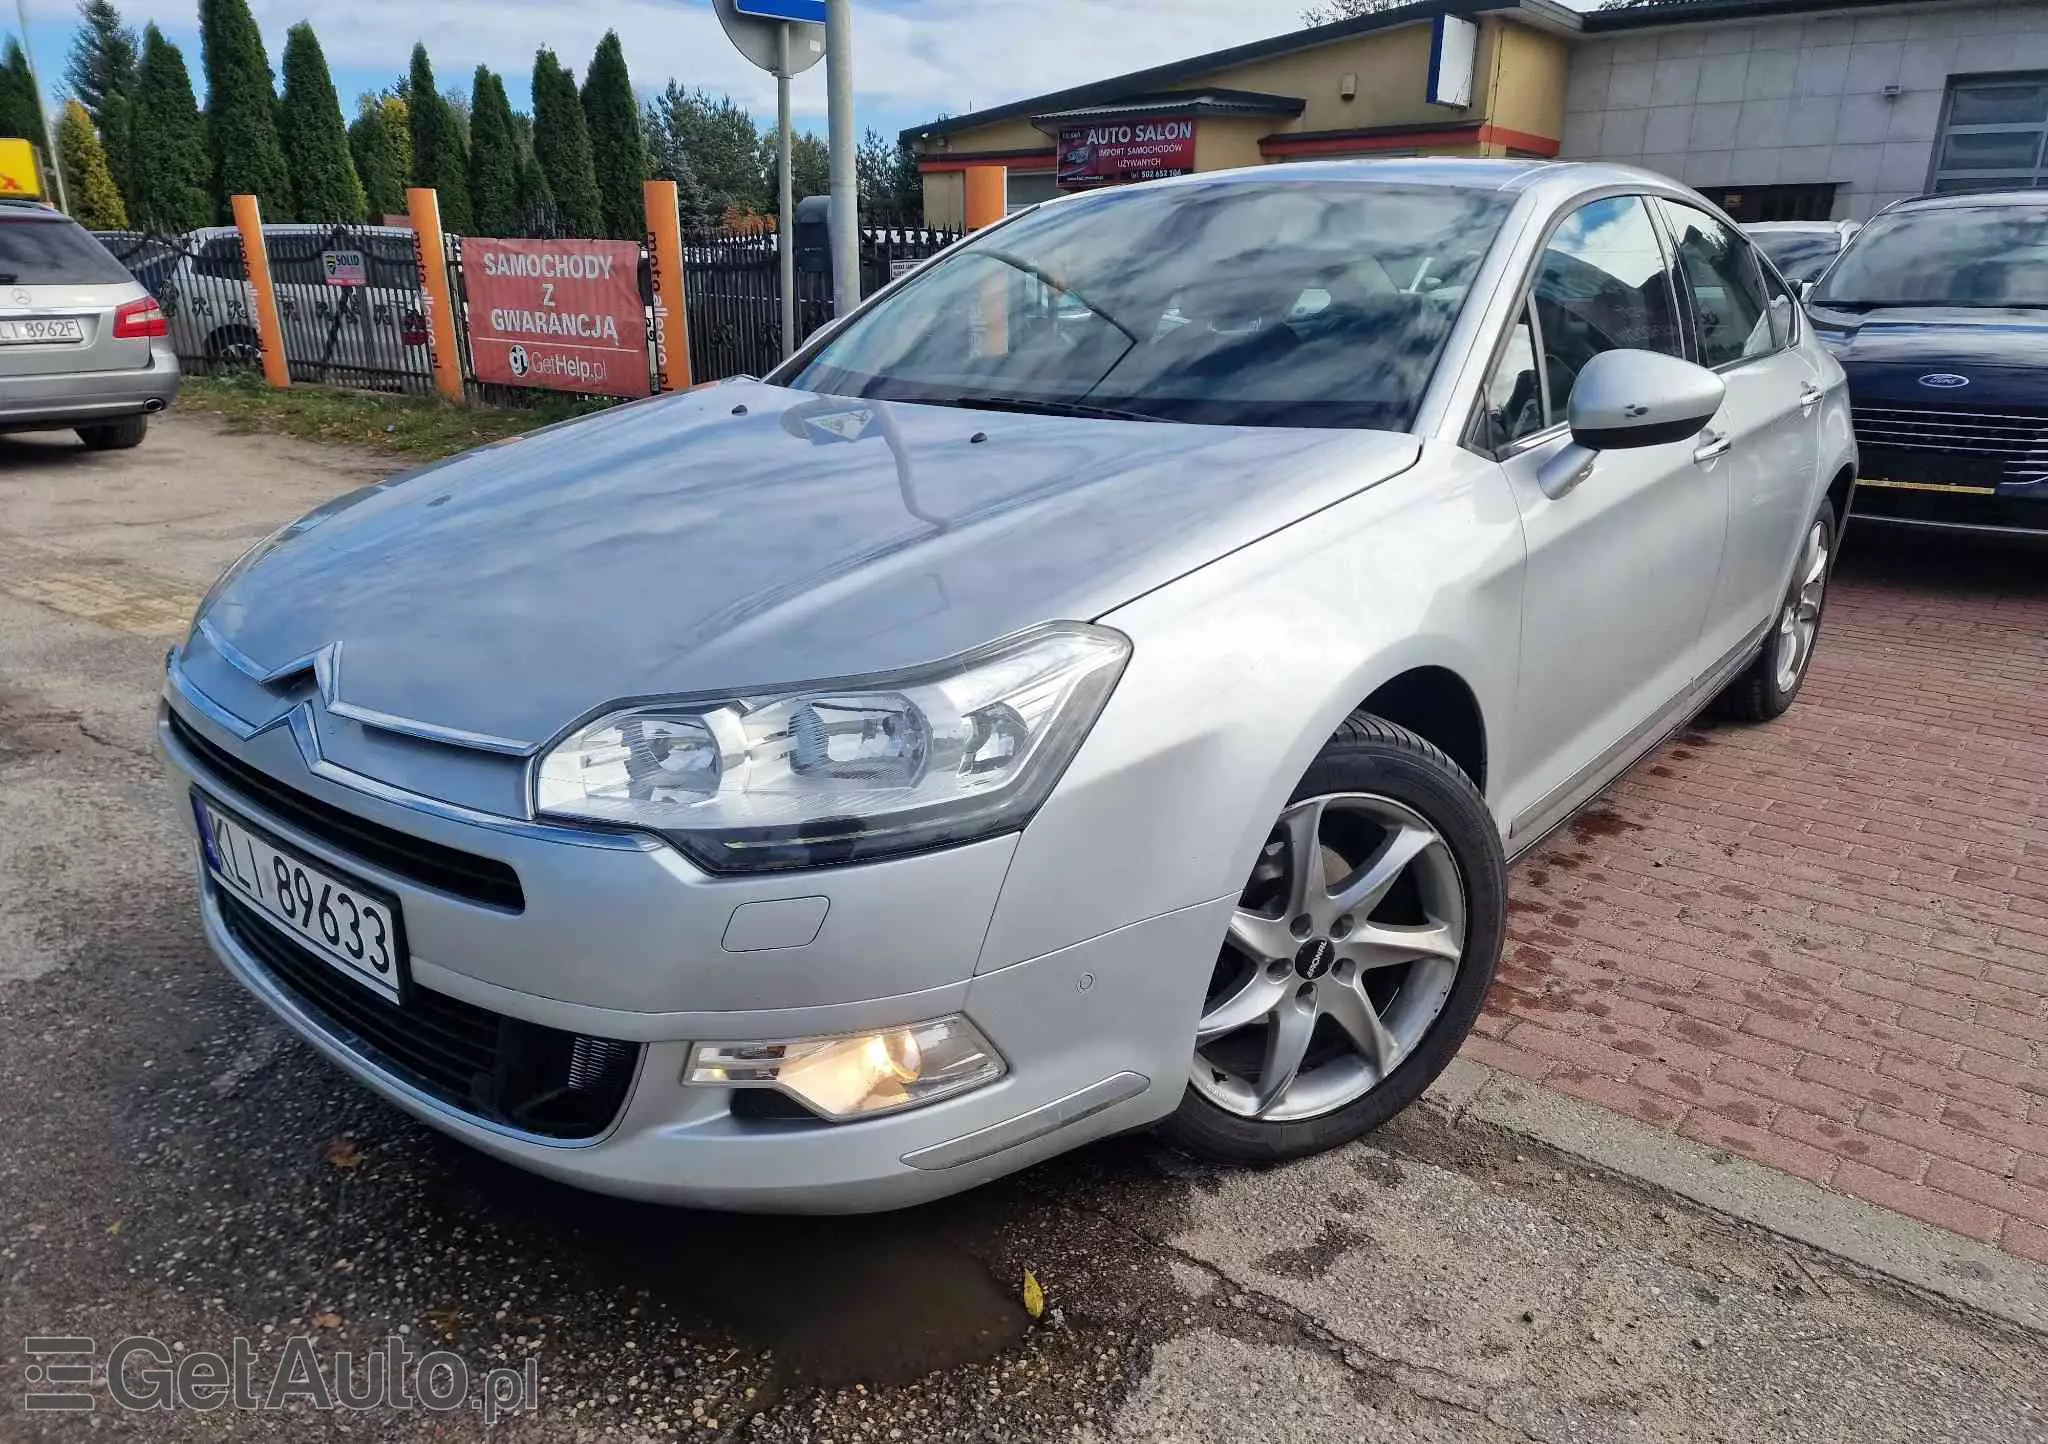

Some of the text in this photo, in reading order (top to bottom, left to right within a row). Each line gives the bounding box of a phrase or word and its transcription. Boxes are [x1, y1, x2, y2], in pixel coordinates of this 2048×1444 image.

[1087, 126, 1131, 144] AUTO
[1135, 121, 1192, 142] SALON
[1099, 147, 1125, 157] IMPORT
[1141, 170, 1153, 178] 502
[1155, 169, 1167, 178] 652
[336, 255, 359, 265] SOLID
[484, 253, 613, 280] SAMOCHODY
[542, 283, 555, 306] Z
[25, 321, 76, 338] 8962F
[491, 308, 619, 345] GWARANCJĄ
[531, 352, 607, 383] GetHelp.pl
[208, 811, 389, 974] KLI 89633
